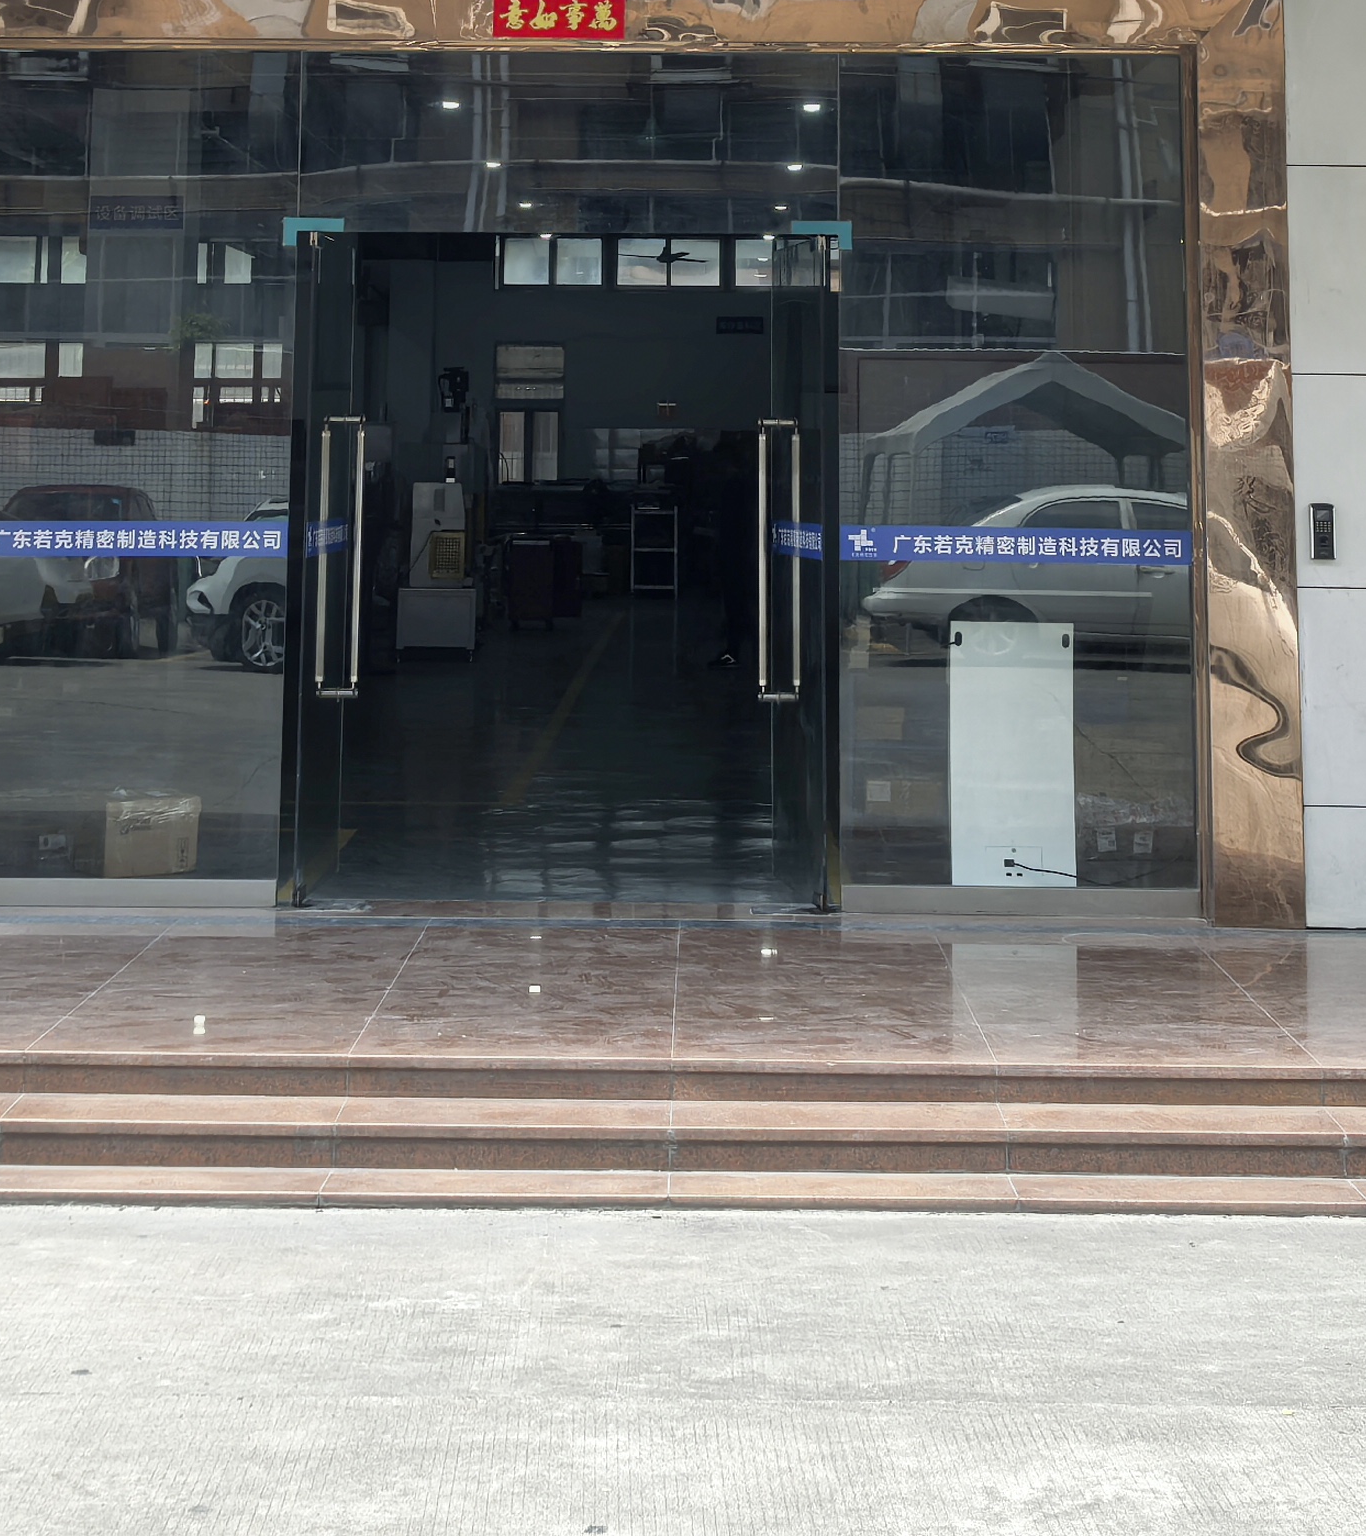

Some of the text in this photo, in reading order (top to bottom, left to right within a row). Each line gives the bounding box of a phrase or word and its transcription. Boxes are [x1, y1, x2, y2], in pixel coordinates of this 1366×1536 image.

[892, 533, 1183, 560] 广东若克精密制造科技有限公司
